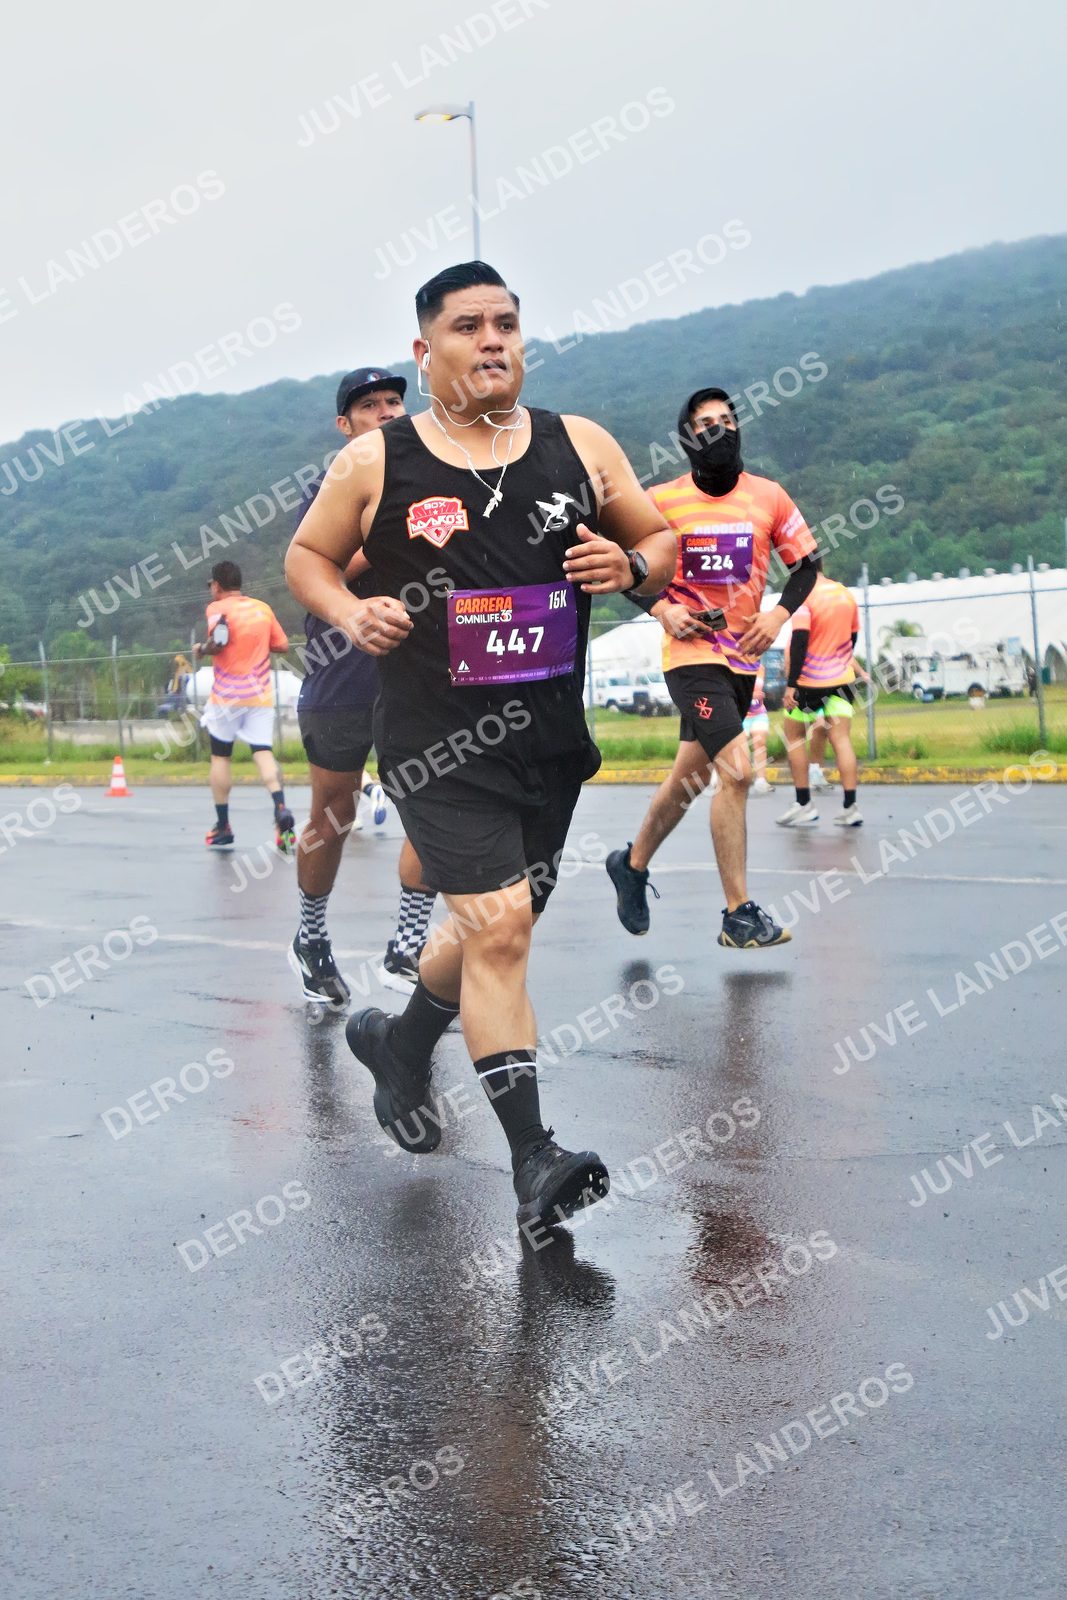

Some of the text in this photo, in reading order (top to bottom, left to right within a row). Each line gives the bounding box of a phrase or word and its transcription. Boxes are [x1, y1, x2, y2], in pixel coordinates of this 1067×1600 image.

[423, 501, 447, 510] BOX
[700, 554, 734, 571] 224
[455, 596, 513, 614] CARRERA
[455, 613, 500, 625] OMNILIFE
[486, 626, 544, 656] 447
